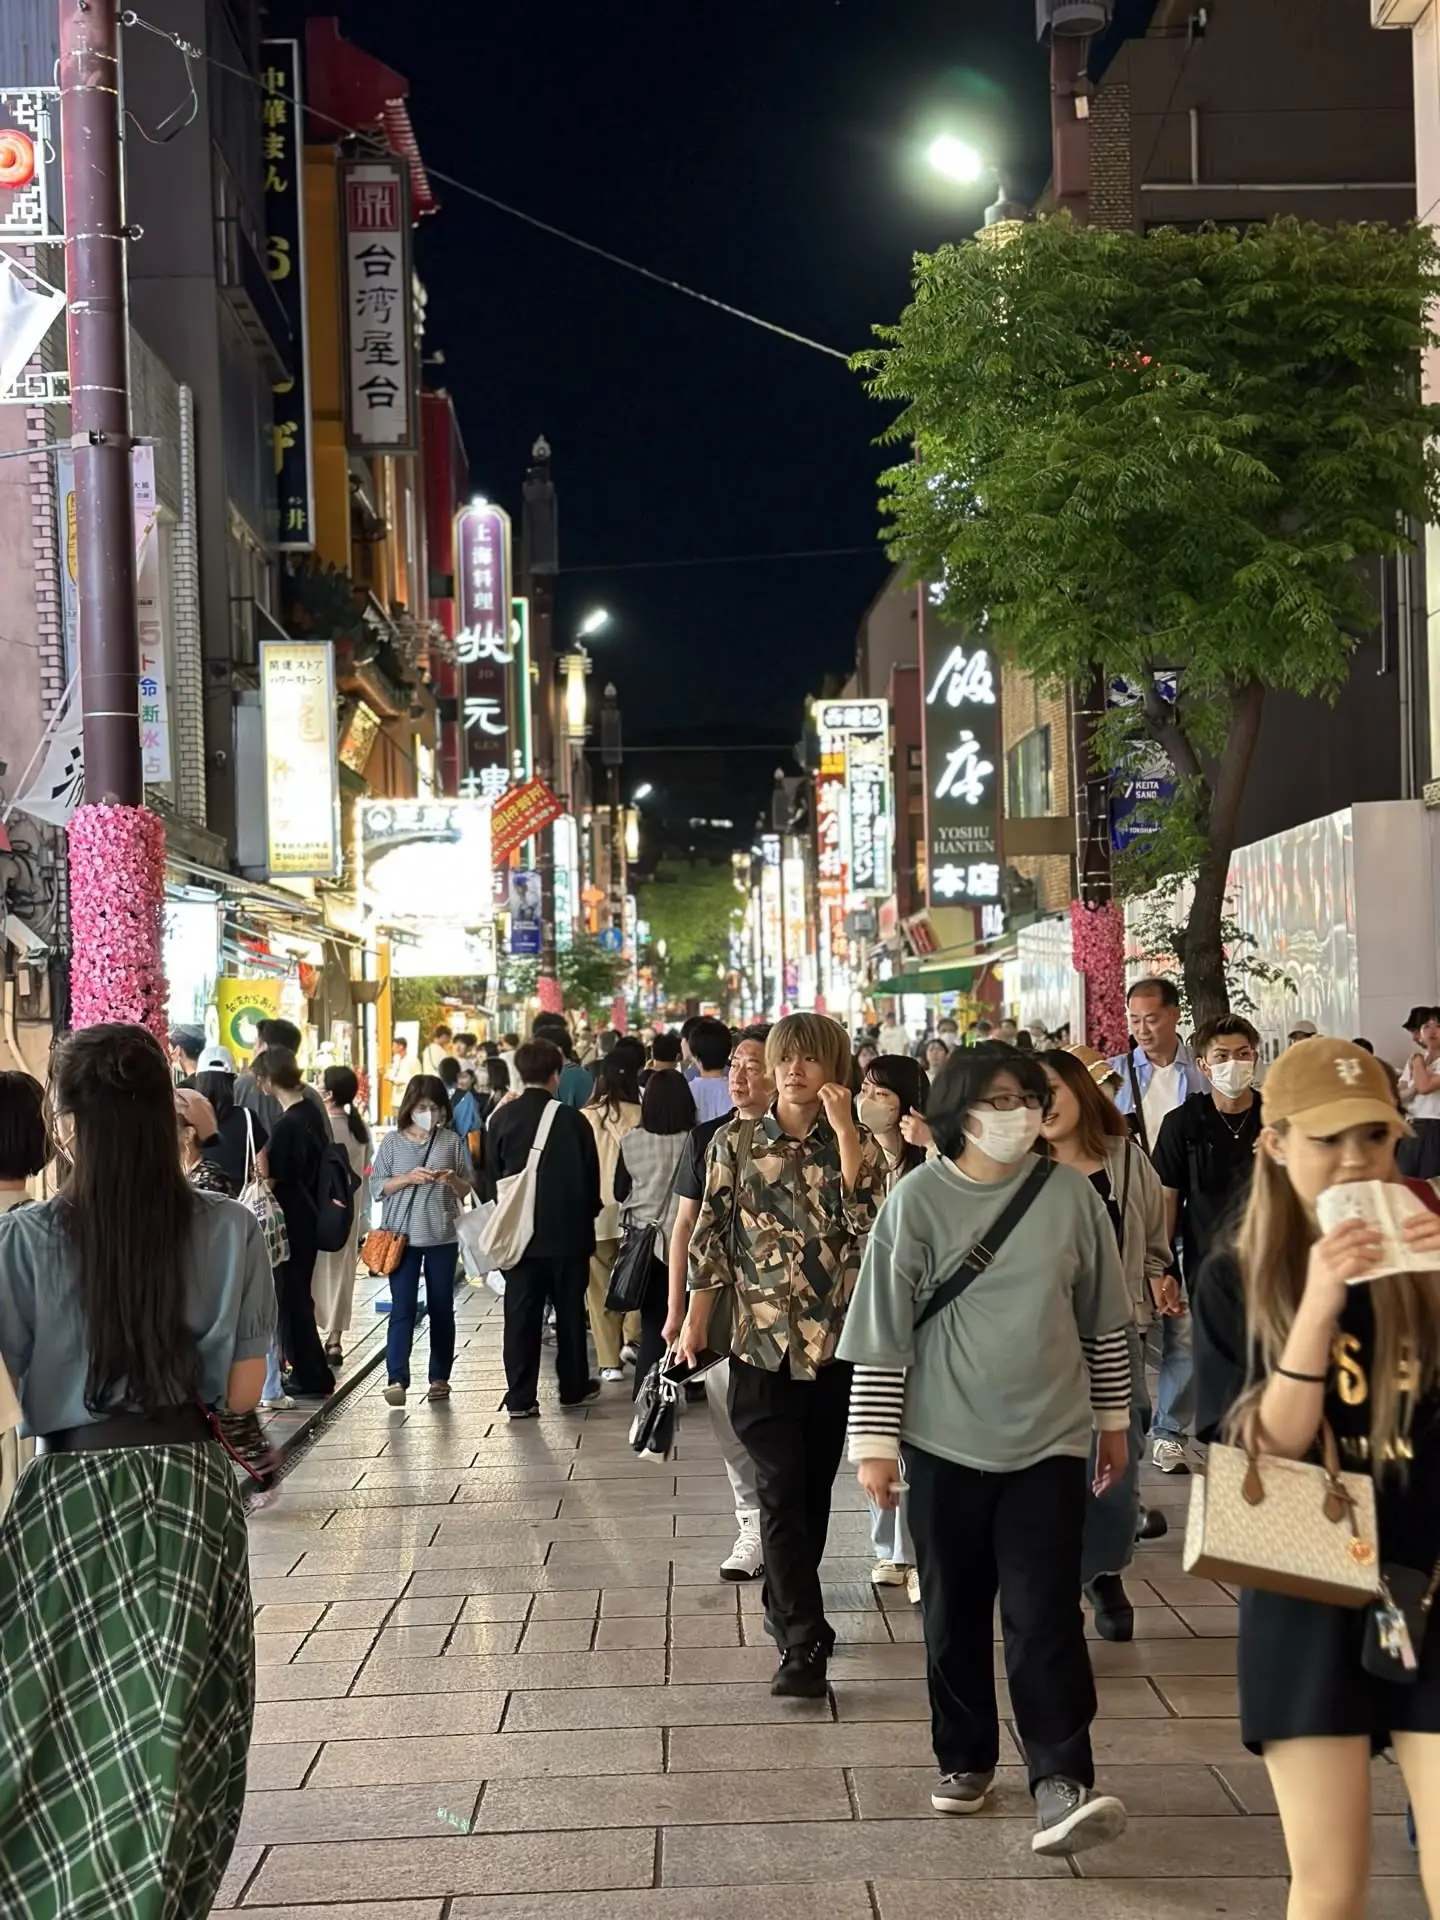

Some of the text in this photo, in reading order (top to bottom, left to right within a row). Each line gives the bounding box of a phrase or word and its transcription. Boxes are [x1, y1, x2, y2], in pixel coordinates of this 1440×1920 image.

[262, 66, 288, 192] 中華まん
[355, 244, 401, 410] 台湾屋台
[471, 522, 495, 611] 上海料理
[1135, 781, 1160, 790] KEITA
[1135, 790, 1158, 799] SANO
[938, 826, 991, 840] YOSHU
[933, 840, 996, 854] HANTEN
[932, 862, 1000, 898] 本店
